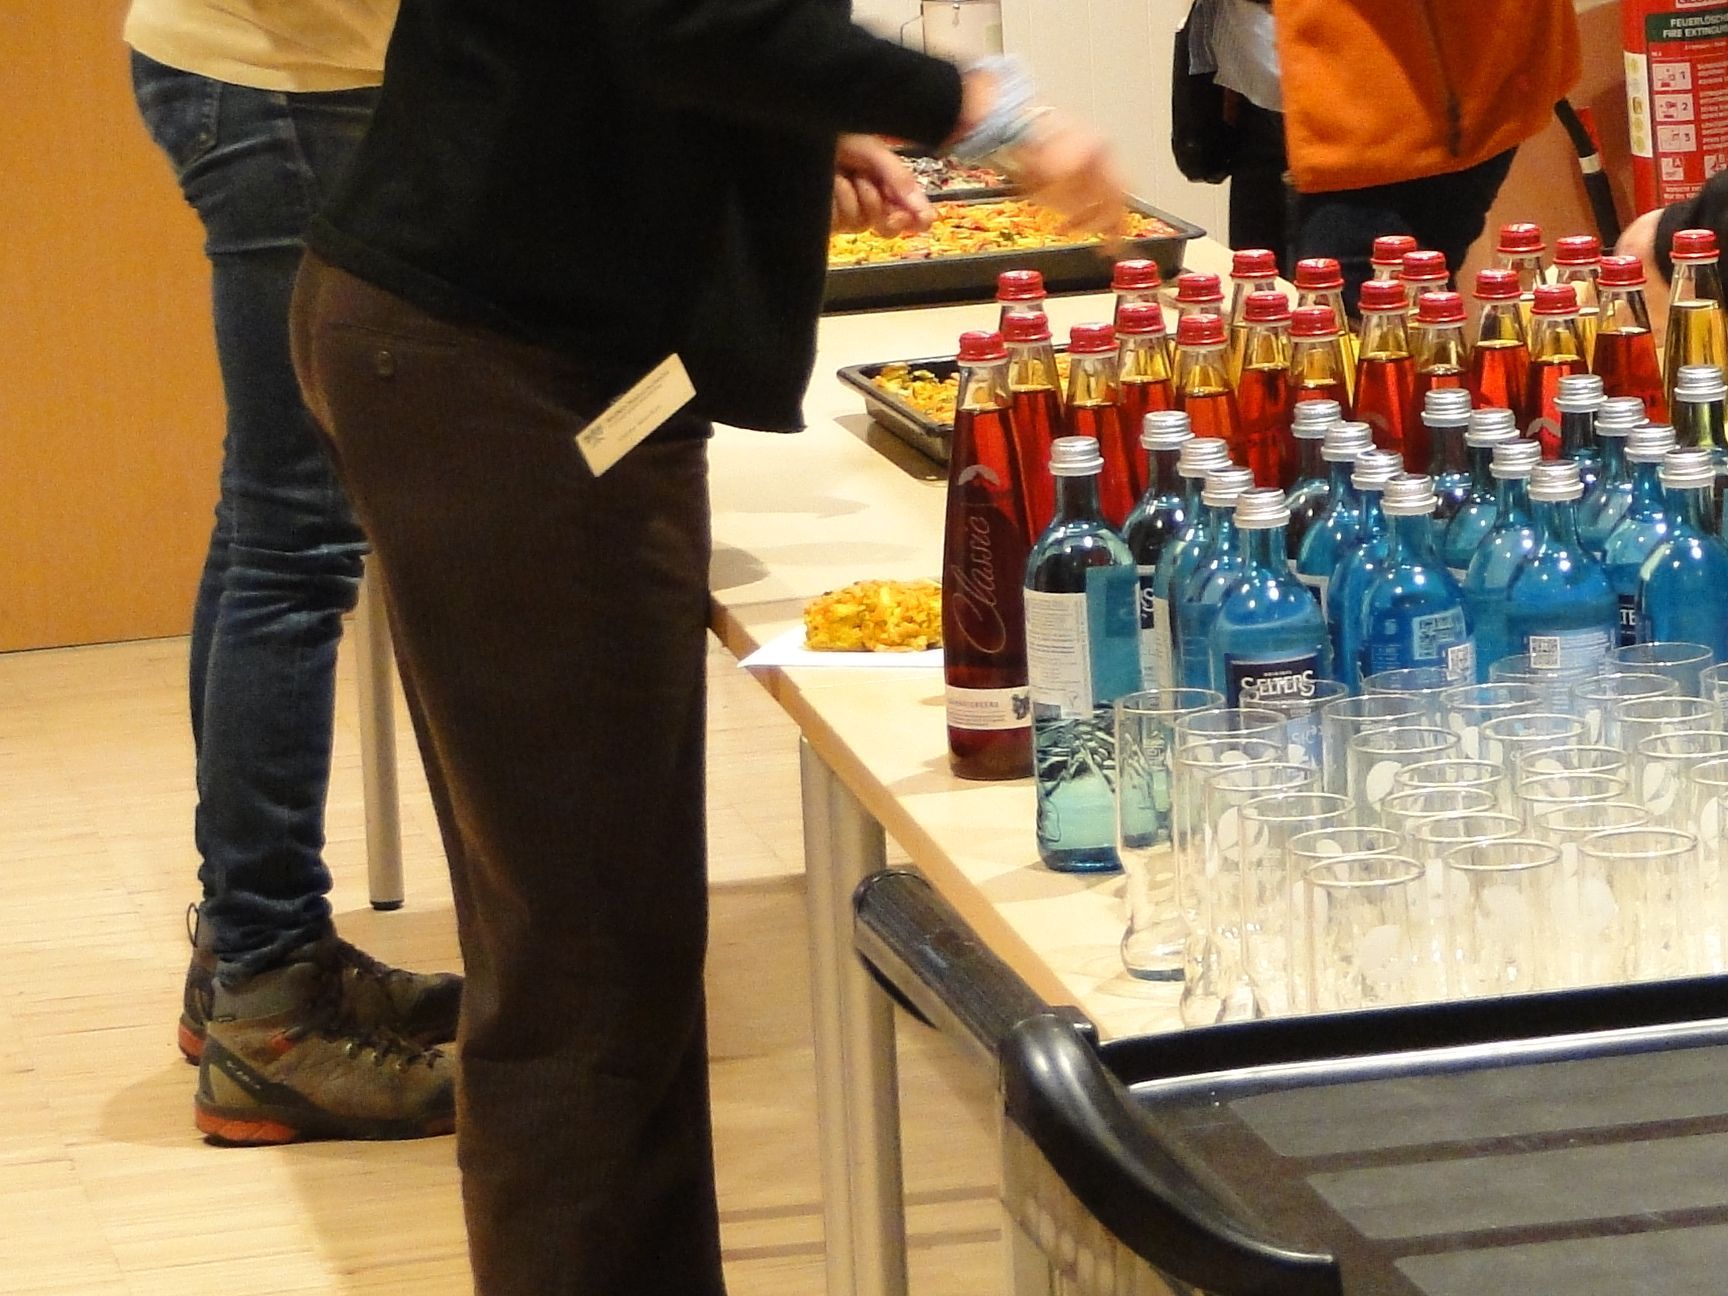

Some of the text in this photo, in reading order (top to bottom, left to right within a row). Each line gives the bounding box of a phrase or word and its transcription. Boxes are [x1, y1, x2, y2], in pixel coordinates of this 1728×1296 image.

[1663, 29, 1683, 39] FIRE
[952, 515, 1006, 654] Classic
[1240, 669, 1316, 701] SELTERS
